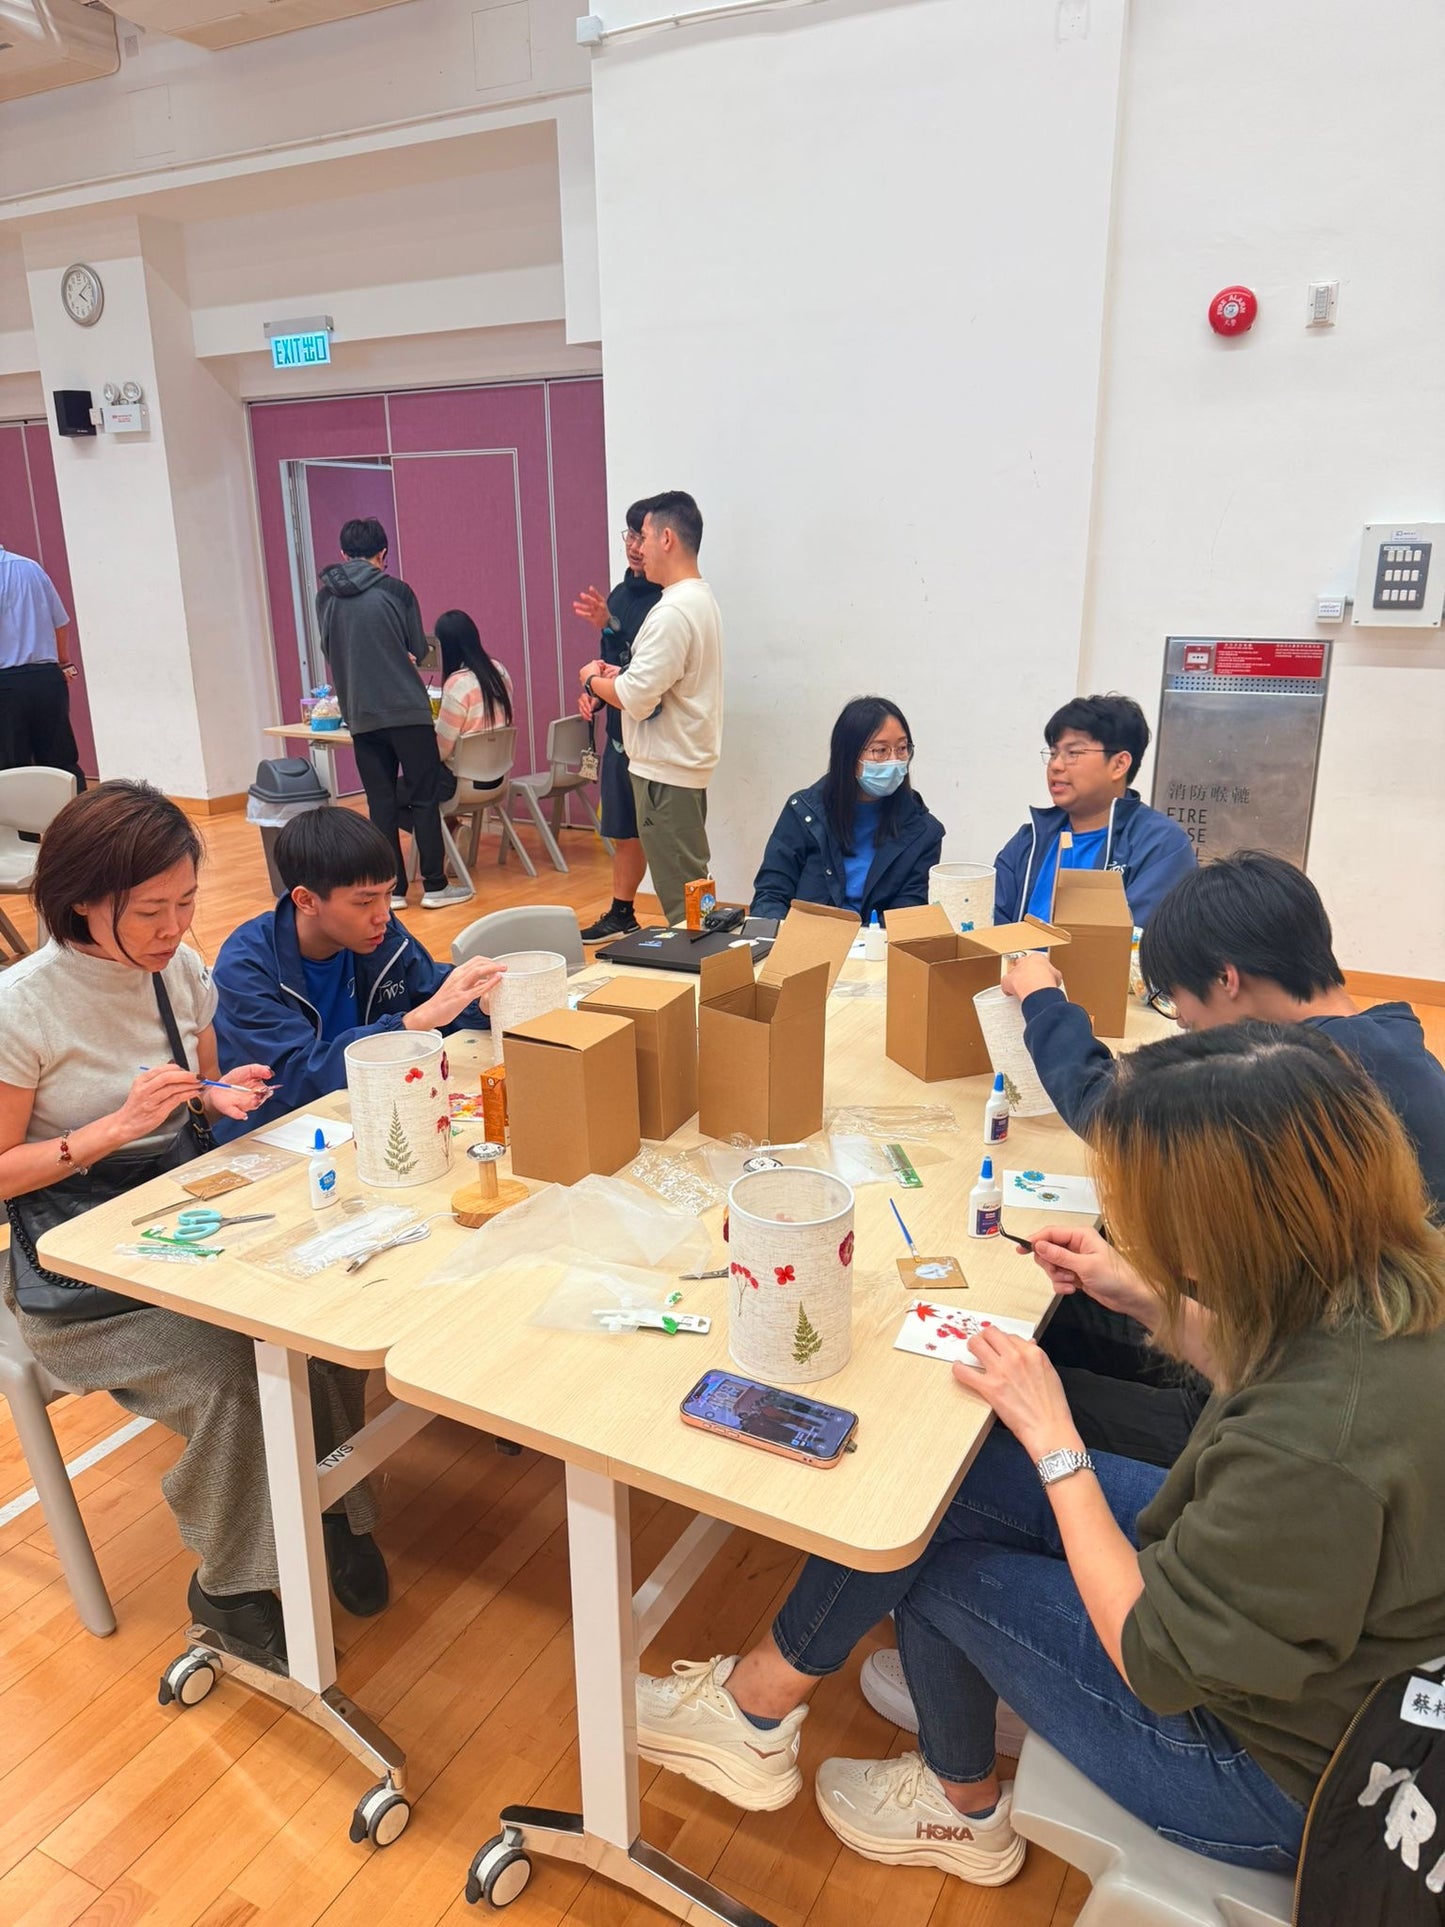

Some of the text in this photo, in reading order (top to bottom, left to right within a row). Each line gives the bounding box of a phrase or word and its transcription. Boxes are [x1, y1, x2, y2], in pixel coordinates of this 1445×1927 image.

[274, 335, 327, 365] EXIT 出口
[1169, 783, 1250, 804] 消防喉轆
[1167, 807, 1208, 824] FIRE
[1187, 827, 1207, 843] SE
[318, 1444, 354, 1468] TWS
[916, 1821, 975, 1841] HOKA
